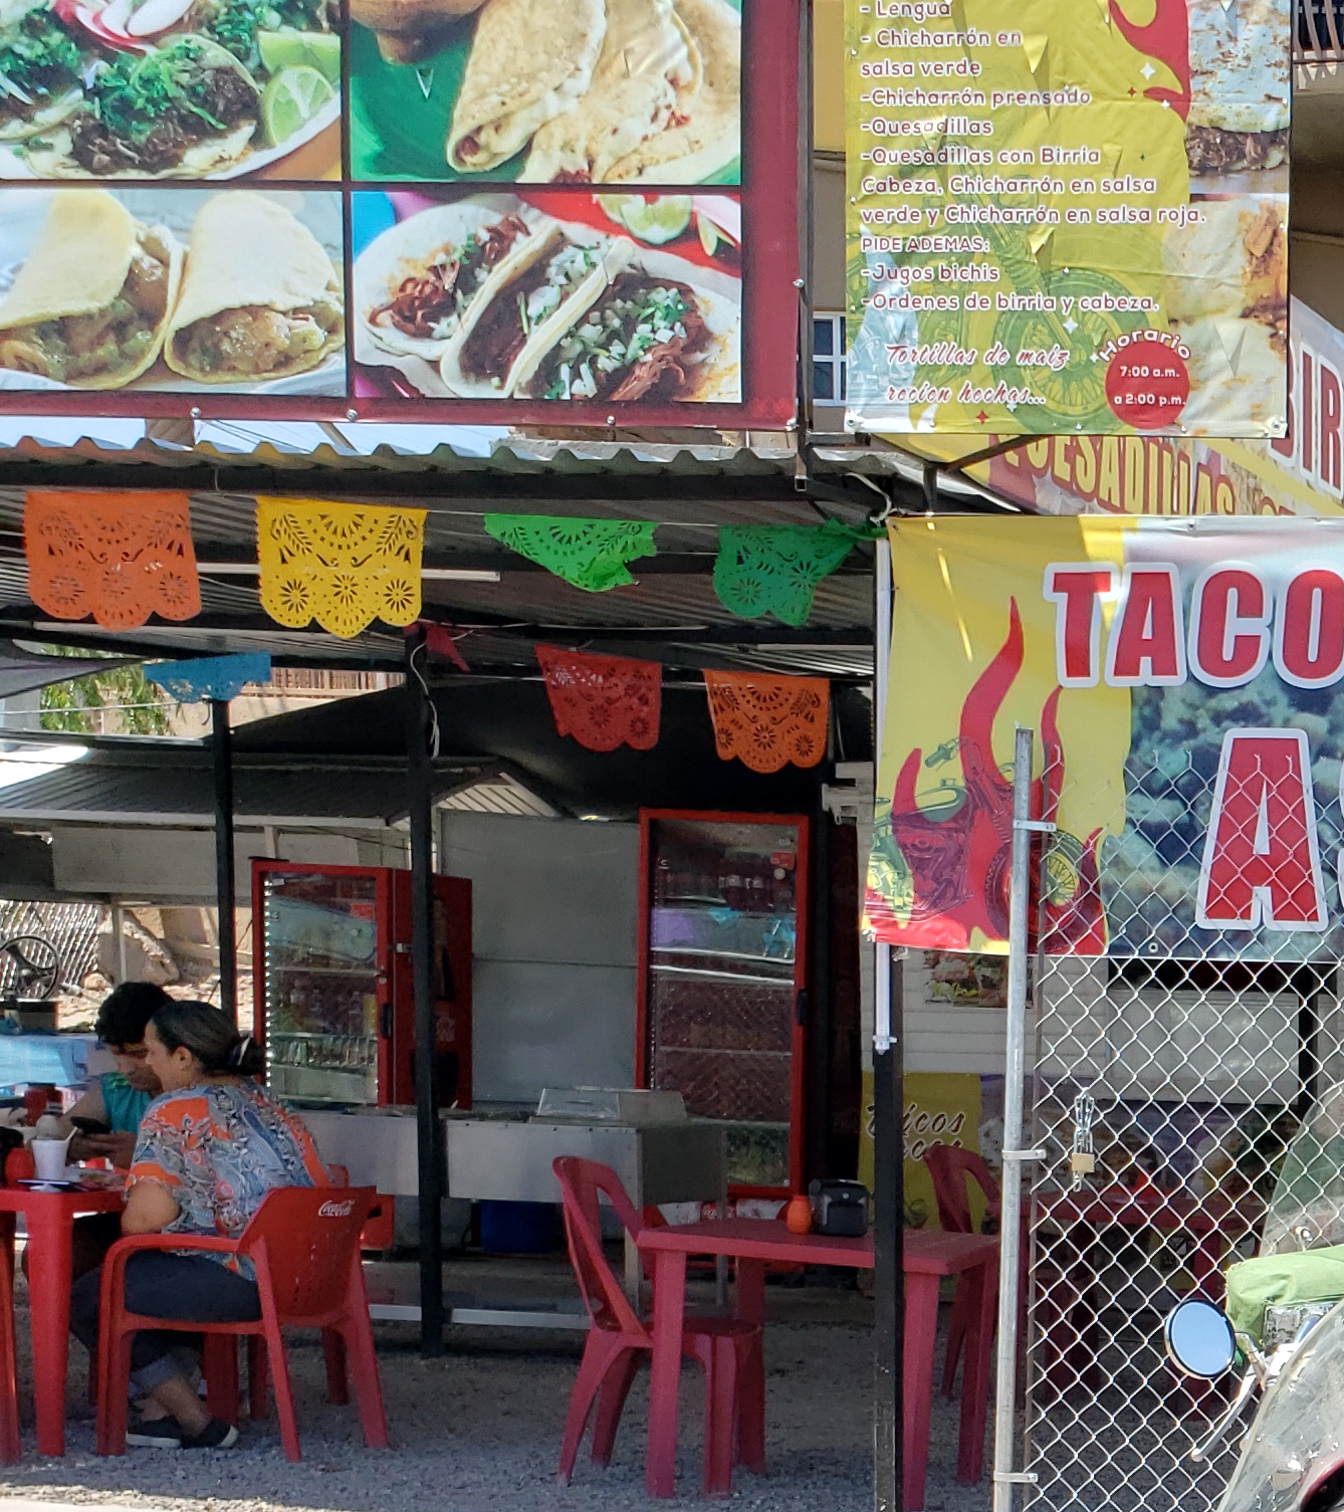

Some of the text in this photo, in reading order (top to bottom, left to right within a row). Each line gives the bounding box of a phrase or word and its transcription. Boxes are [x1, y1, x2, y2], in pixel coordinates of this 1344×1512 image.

[875, 0, 952, 20] Lengua
[876, 28, 990, 48] Chicharrón
[996, 31, 1022, 46] en
[859, 58, 980, 76] salsa verde
[859, 87, 1092, 110] -Chicharrón prensado
[999, 150, 1036, 165] con
[1040, 147, 1100, 164] Birria
[861, 175, 1157, 196] Cabeza, Chicharrón en salsa
[861, 206, 1206, 227] verde y Chicharrón en salsa roja.
[861, 235, 990, 253] PIDE ADEMAS:
[860, 263, 999, 286] -Jugos bichis
[966, 293, 991, 311] de
[997, 293, 1057, 312] birria
[1061, 297, 1074, 315] y
[1079, 294, 1159, 312] cabeza.
[1099, 327, 1191, 363] Horario
[885, 343, 1070, 369] Tortillas de maíz
[1119, 365, 1179, 378] 7:00 a.m.
[886, 382, 952, 404] recien
[1114, 393, 1186, 408] a 2:00 p.m.
